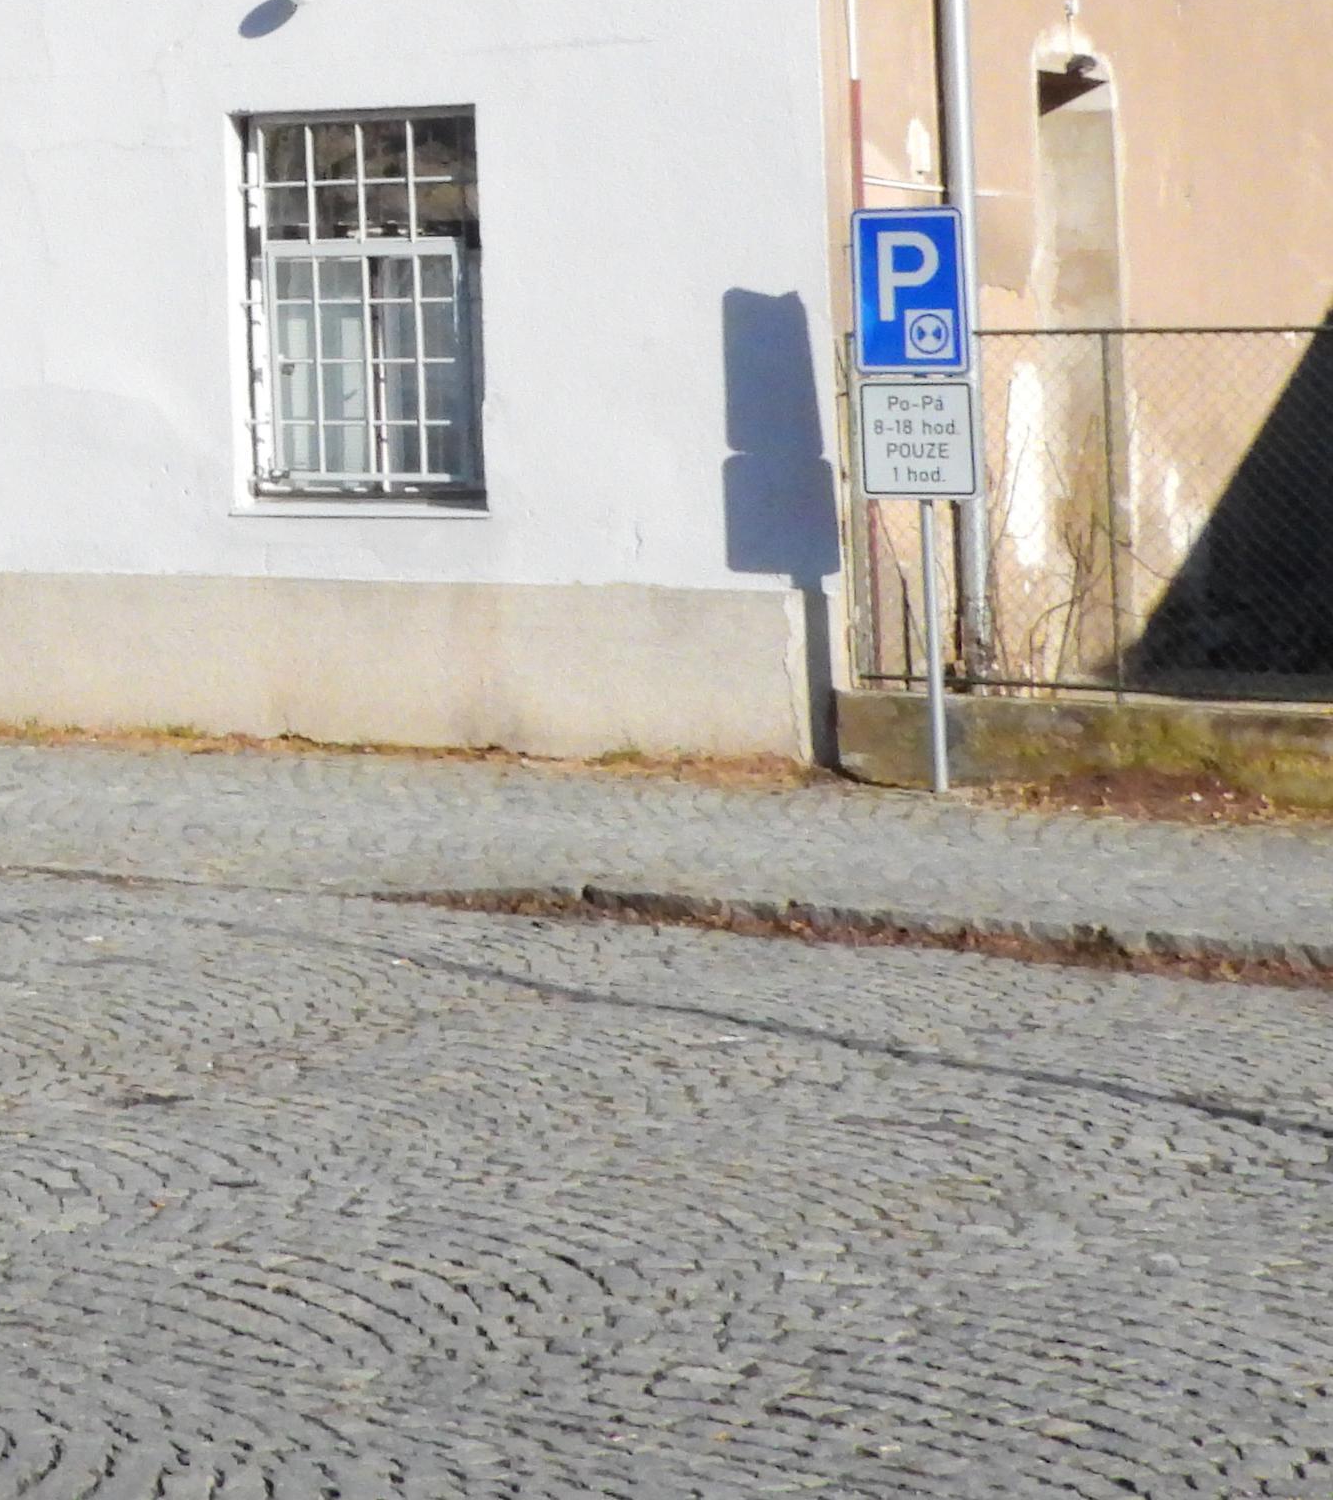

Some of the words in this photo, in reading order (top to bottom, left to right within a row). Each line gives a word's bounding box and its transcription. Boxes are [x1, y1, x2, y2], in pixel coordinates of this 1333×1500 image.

[877, 231, 940, 322] P
[887, 395, 944, 411] Po-Pá
[873, 419, 913, 435] 8-18
[922, 419, 961, 435] hod.
[886, 442, 950, 459] POUZE
[893, 466, 899, 482] 1
[907, 466, 946, 482] hod.
